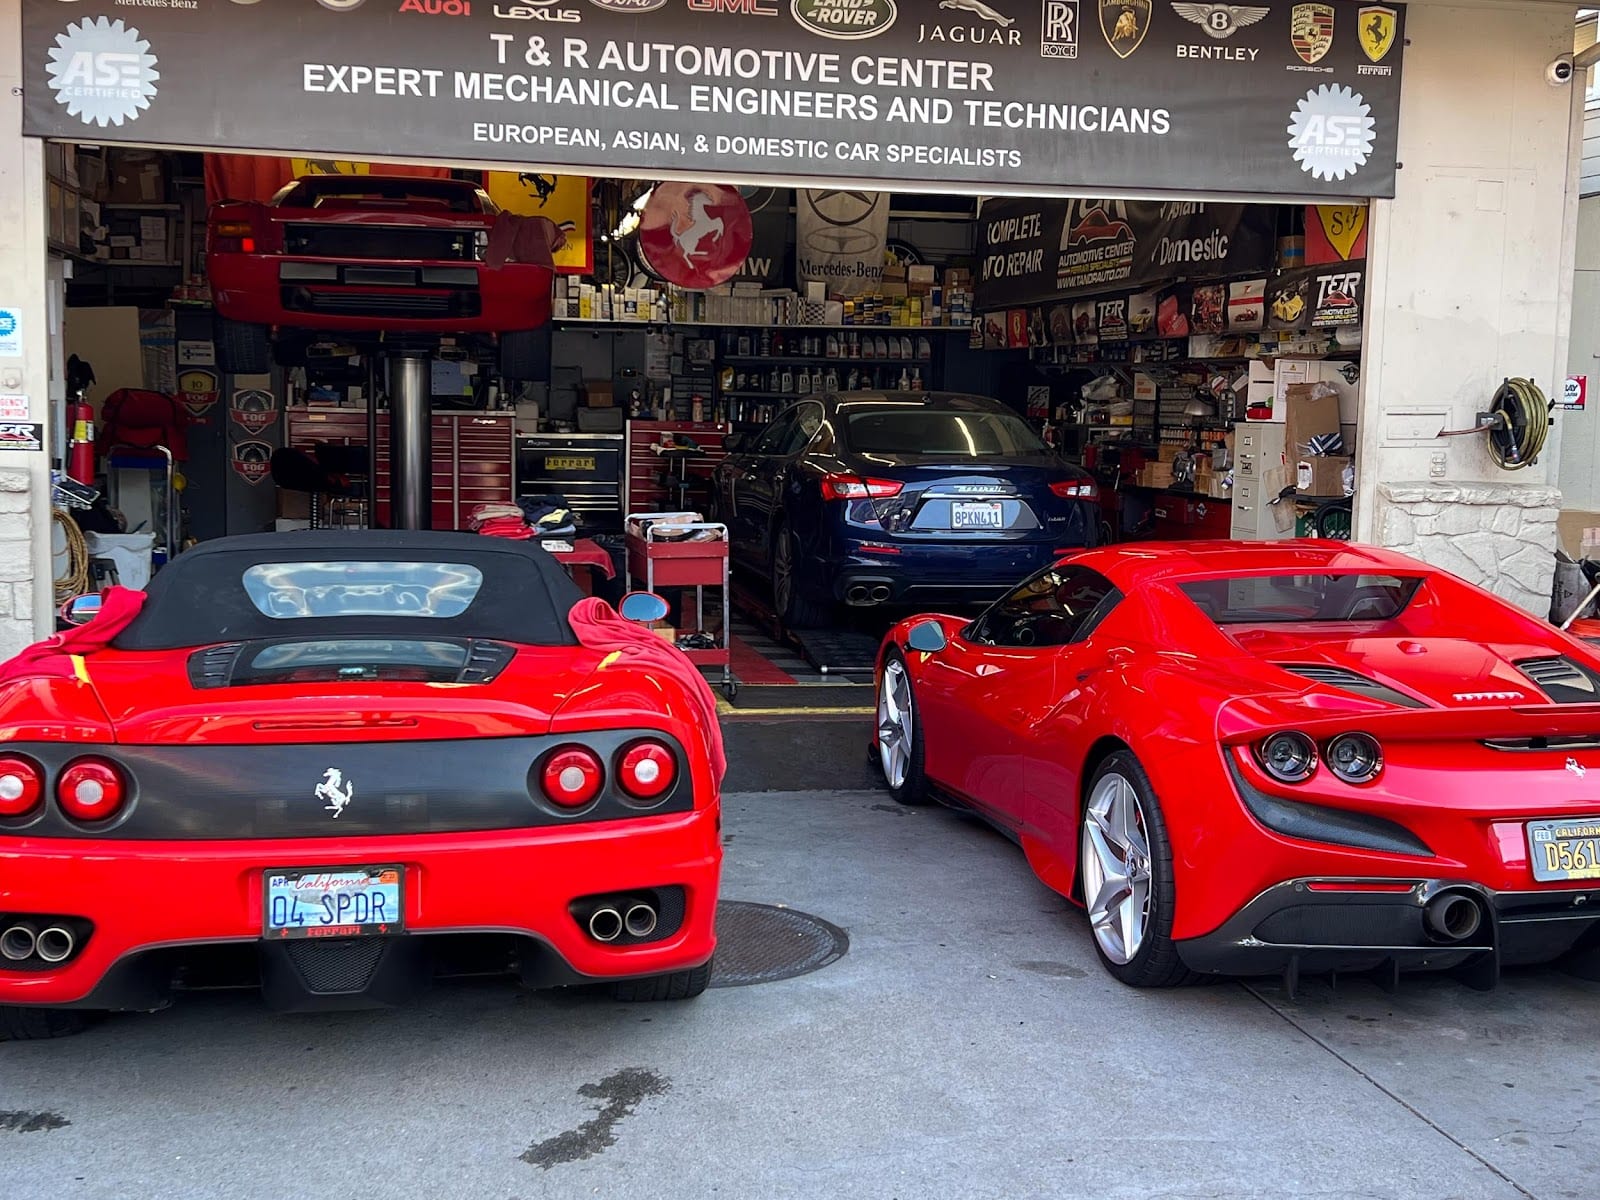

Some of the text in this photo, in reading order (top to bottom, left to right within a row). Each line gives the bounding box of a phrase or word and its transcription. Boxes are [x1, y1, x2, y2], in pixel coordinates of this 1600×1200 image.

[493, 5, 582, 23] LEXUS
[817, 7, 877, 25] ROVER
[1294, 5, 1333, 14] PORSCHE
[918, 24, 1022, 46] JAGUAR
[1043, 45, 1075, 56] ROYCE
[1176, 44, 1259, 61] BENTLEY
[60, 51, 140, 86] ASE
[490, 33, 994, 91] T & R AUTOMOTIVE CENTER
[1286, 65, 1334, 73] PORSCHE
[1357, 64, 1392, 76] Ferrari
[64, 86, 141, 99] CERTIFIED
[303, 63, 1170, 135] EXPERT MECHANICAL ENGINEERS AND TECHNICIANS
[1298, 114, 1361, 146] ASE
[473, 122, 1022, 168] EUROPEAN, ASIAN, & DOMESTIC CAR SPECIALISTS
[1058, 241, 1134, 267] AUTOMOTIVE CENTER
[1160, 228, 1228, 265] Domestic
[800, 259, 884, 278] Mercedes-Benz
[1006, 248, 1043, 277] REPAIR
[241, 413, 266, 421] FOG
[955, 511, 1000, 525] 8PKN411
[272, 878, 289, 887] APR
[295, 873, 371, 892] California
[319, 892, 386, 924] SPDR
[306, 925, 361, 937] Ferrari
